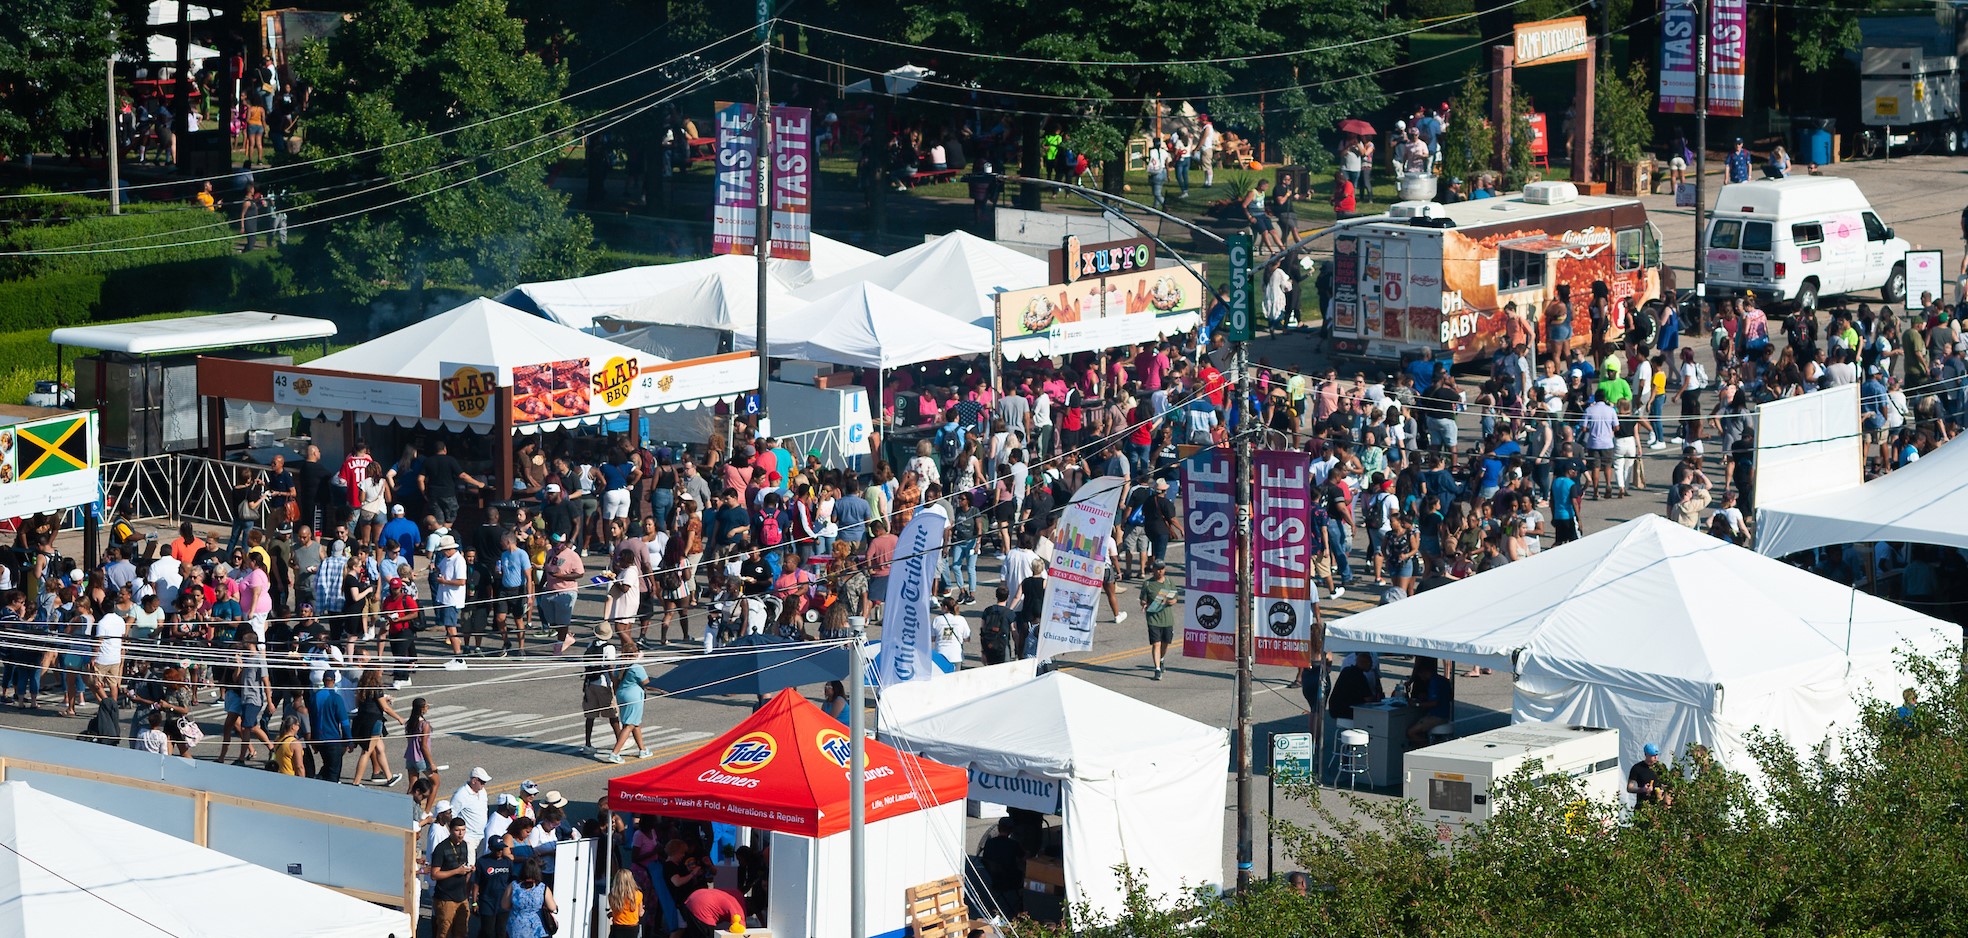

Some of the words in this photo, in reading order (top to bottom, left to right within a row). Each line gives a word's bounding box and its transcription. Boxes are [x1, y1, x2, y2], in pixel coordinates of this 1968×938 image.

[1517, 32, 1540, 59] CAMP
[1541, 26, 1587, 56] DOORDASH
[1664, 0, 1693, 69] TAST
[719, 112, 753, 204] TASTE
[775, 116, 807, 209] TASTE
[714, 235, 726, 243] CITY
[726, 236, 732, 244] OF
[732, 236, 754, 245] CHICAGO
[772, 240, 782, 248] CITY
[783, 241, 789, 249] OF
[789, 242, 809, 250] CHICAGO
[1082, 244, 1149, 275] xurro
[1385, 272, 1401, 281] THE
[1230, 246, 1246, 330] C520
[1389, 284, 1397, 299] 1
[1613, 281, 1632, 297] THE
[1441, 290, 1462, 315] OH
[1051, 327, 1061, 338] 44
[1441, 312, 1480, 343] BABY
[275, 375, 287, 387] 43
[592, 357, 639, 396] SLAB
[641, 377, 652, 388] 43
[442, 371, 497, 402] SLAB
[606, 384, 630, 403] BBQ
[458, 397, 485, 413] BBQ
[354, 467, 366, 483] 11
[1074, 502, 1113, 519] Summer
[1187, 458, 1230, 587] TASTE
[1261, 463, 1305, 594] TASTE
[900, 524, 928, 602] Tribune
[1056, 556, 1102, 575] CHICAGO
[1053, 570, 1067, 578] STAY
[1200, 596, 1217, 606] GOOSE
[1273, 604, 1291, 613] GOOSE
[1200, 618, 1218, 627] ISLAND
[1273, 625, 1293, 634] ISLAND
[894, 605, 921, 681] Chicago
[1043, 631, 1068, 643] Chicago
[1068, 635, 1091, 646] Tribune
[1185, 631, 1199, 641] CITY
[1199, 633, 1207, 643] OF
[1208, 633, 1234, 646] CHICAGO
[1258, 639, 1272, 649] CITY
[1273, 640, 1281, 650] OF
[1282, 641, 1309, 652] CHICAGO
[720, 740, 771, 765] Tide
[823, 737, 850, 767] Tid
[698, 769, 760, 789] Cleaners
[620, 791, 634, 802] Dry
[635, 793, 668, 806] Cleaning
[674, 797, 695, 807] Wash
[696, 800, 702, 808] &
[704, 800, 720, 810] Fold
[726, 804, 768, 819] Alterations
[769, 811, 775, 819] &
[776, 812, 805, 824] Repairs
[871, 798, 884, 810] Life,
[884, 796, 895, 804] Not
